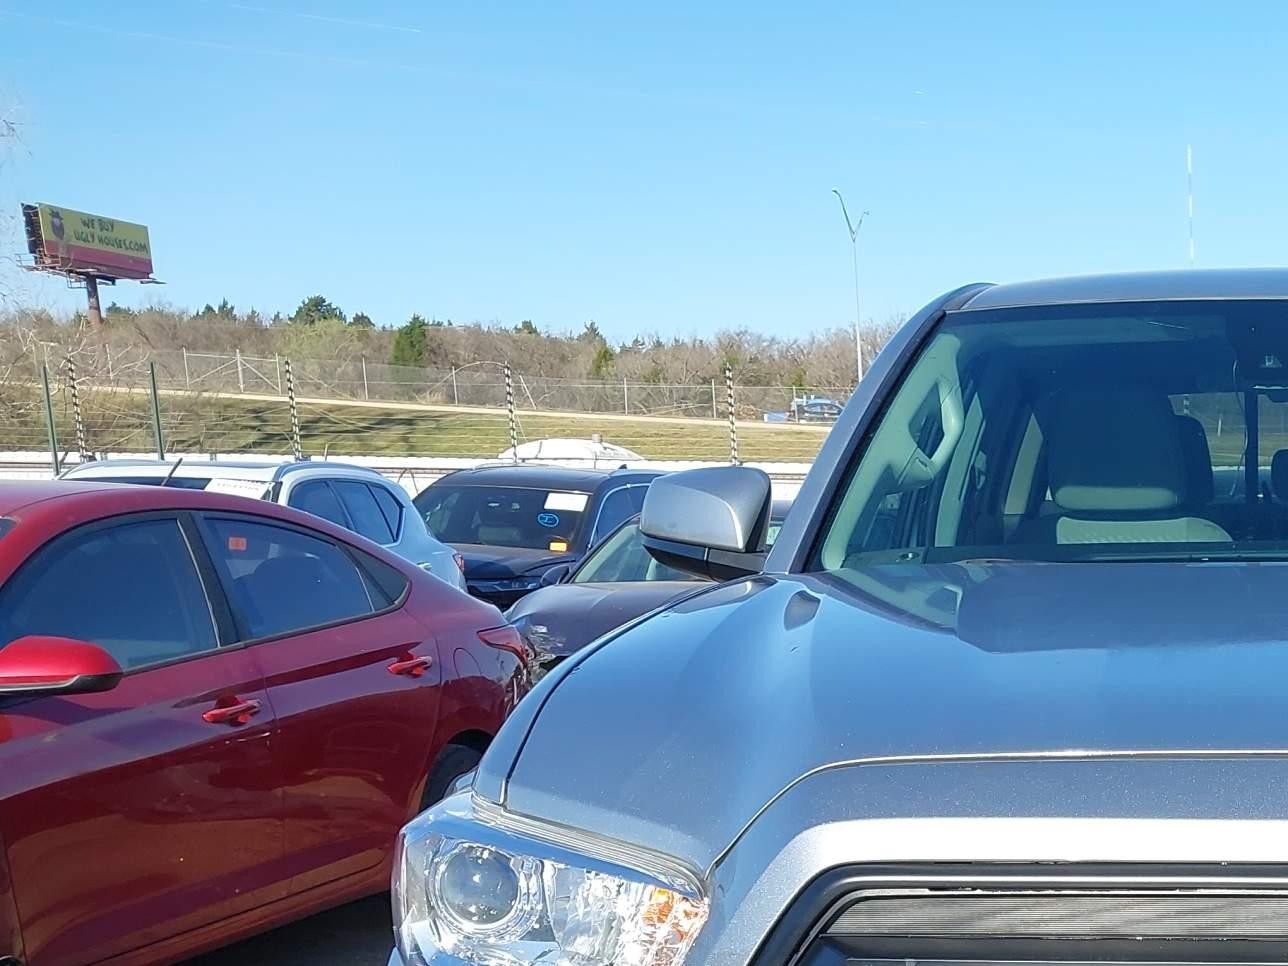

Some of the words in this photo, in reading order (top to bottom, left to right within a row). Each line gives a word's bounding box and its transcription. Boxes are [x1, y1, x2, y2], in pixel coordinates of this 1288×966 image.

[80, 217, 95, 229] WE
[98, 218, 115, 232] BUY
[73, 229, 96, 243] UGLY
